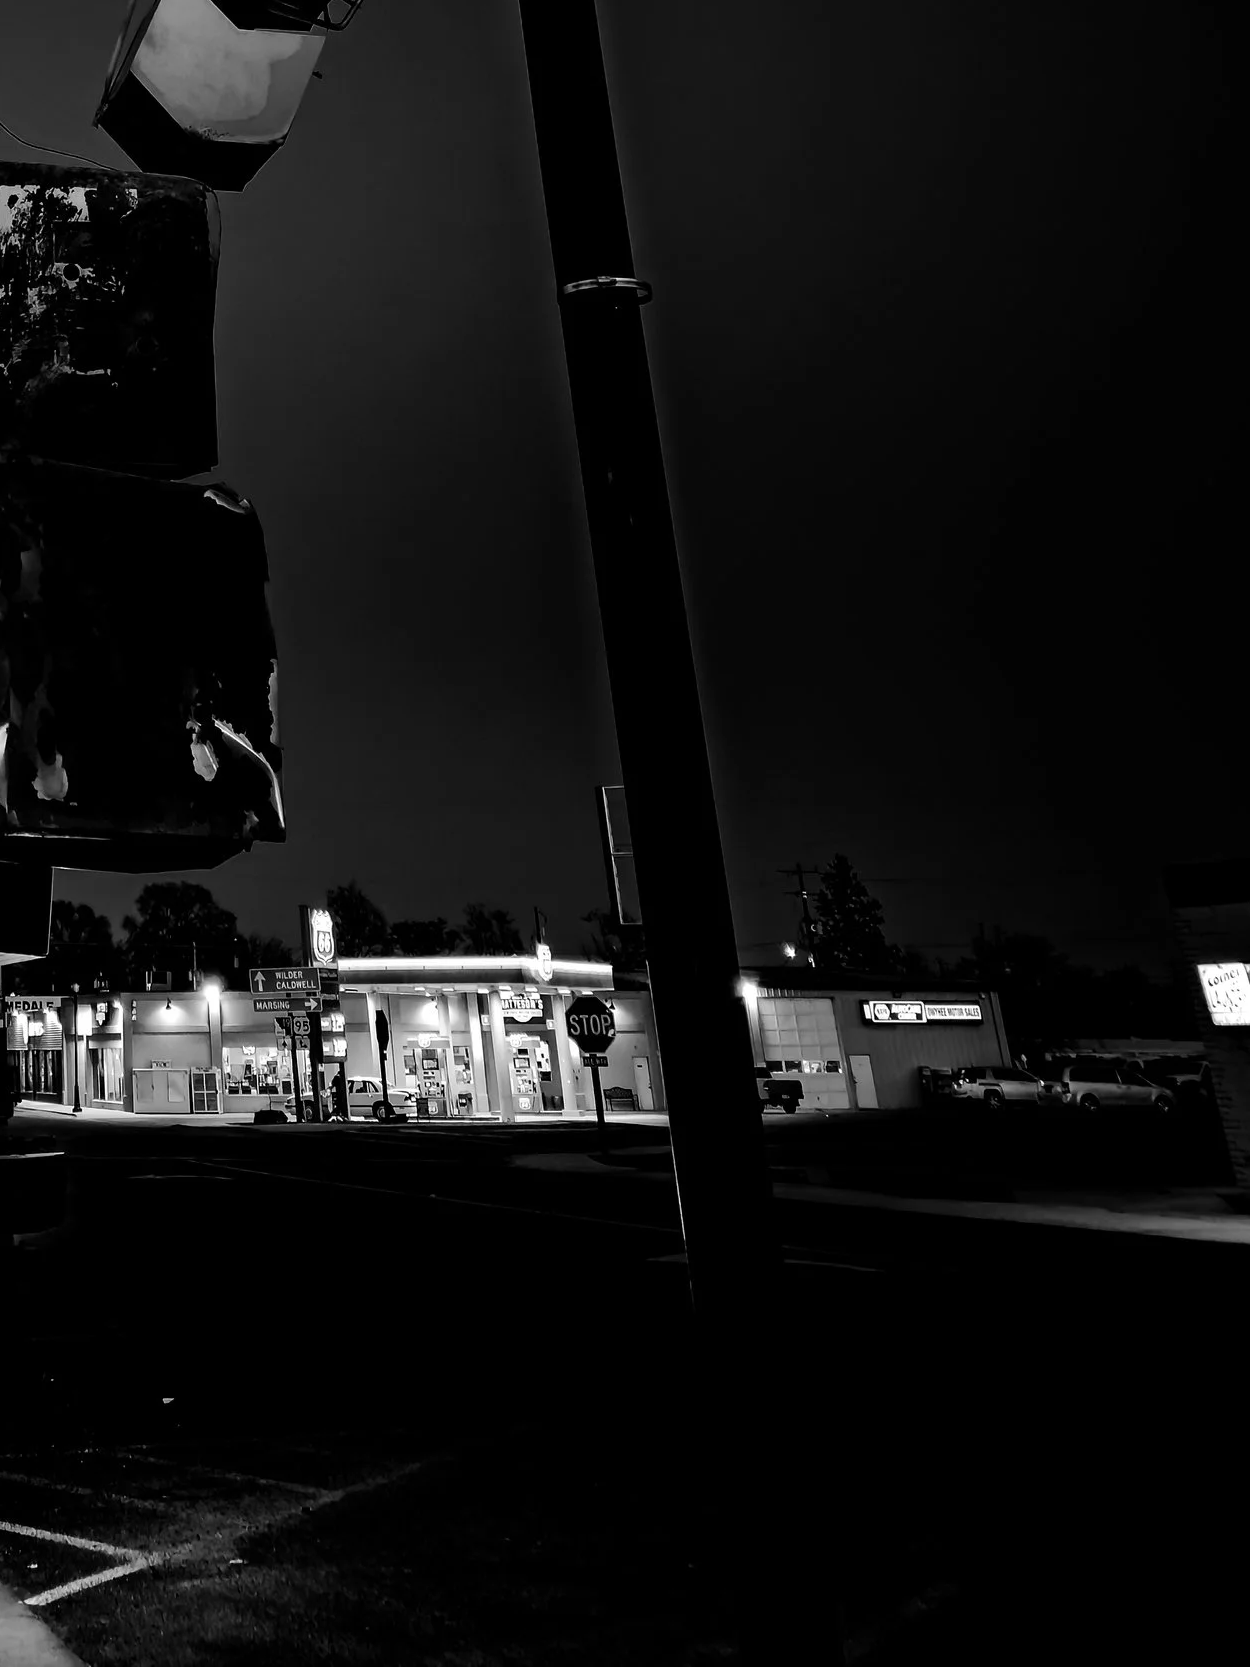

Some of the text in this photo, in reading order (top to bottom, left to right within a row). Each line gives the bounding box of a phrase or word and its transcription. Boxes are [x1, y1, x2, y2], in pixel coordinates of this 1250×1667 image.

[275, 971, 303, 979] WILDER
[276, 981, 317, 990] CALDWELL
[256, 1001, 290, 1010] MARSING
[964, 1008, 980, 1018] SALES
[294, 1020, 309, 1032] 95
[569, 1014, 611, 1035] STOP
